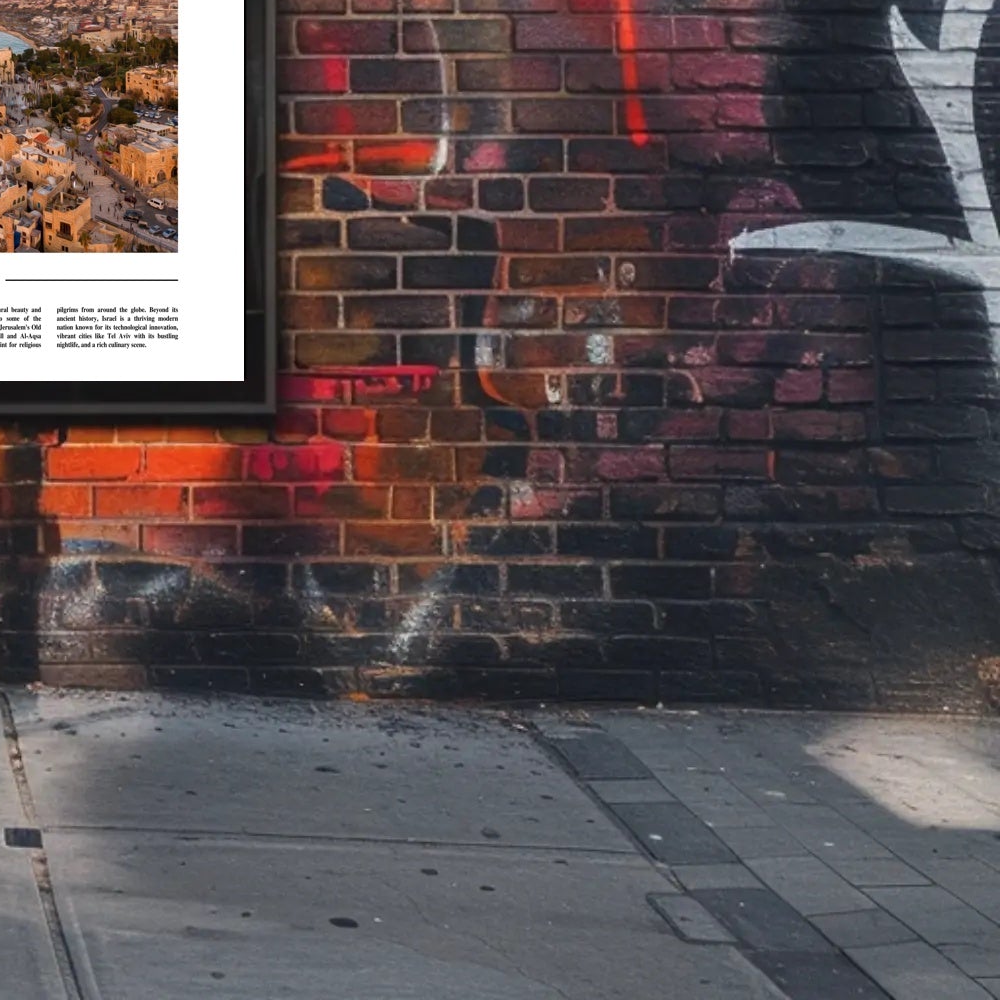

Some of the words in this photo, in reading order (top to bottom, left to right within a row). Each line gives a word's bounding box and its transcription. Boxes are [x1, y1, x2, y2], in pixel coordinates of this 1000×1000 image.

[10, 306, 29, 314] beauty
[56, 306, 79, 315] pilgrims
[130, 306, 147, 314] globe.
[149, 306, 169, 314] Beyond
[78, 315, 99, 323] history,
[133, 315, 155, 323] thriving
[113, 324, 148, 332] technological
[20, 332, 42, 341] Al-Aqsa
[18, 341, 42, 349] religious
[56, 341, 80, 349] nightlife,
[108, 341, 130, 350] culinary
